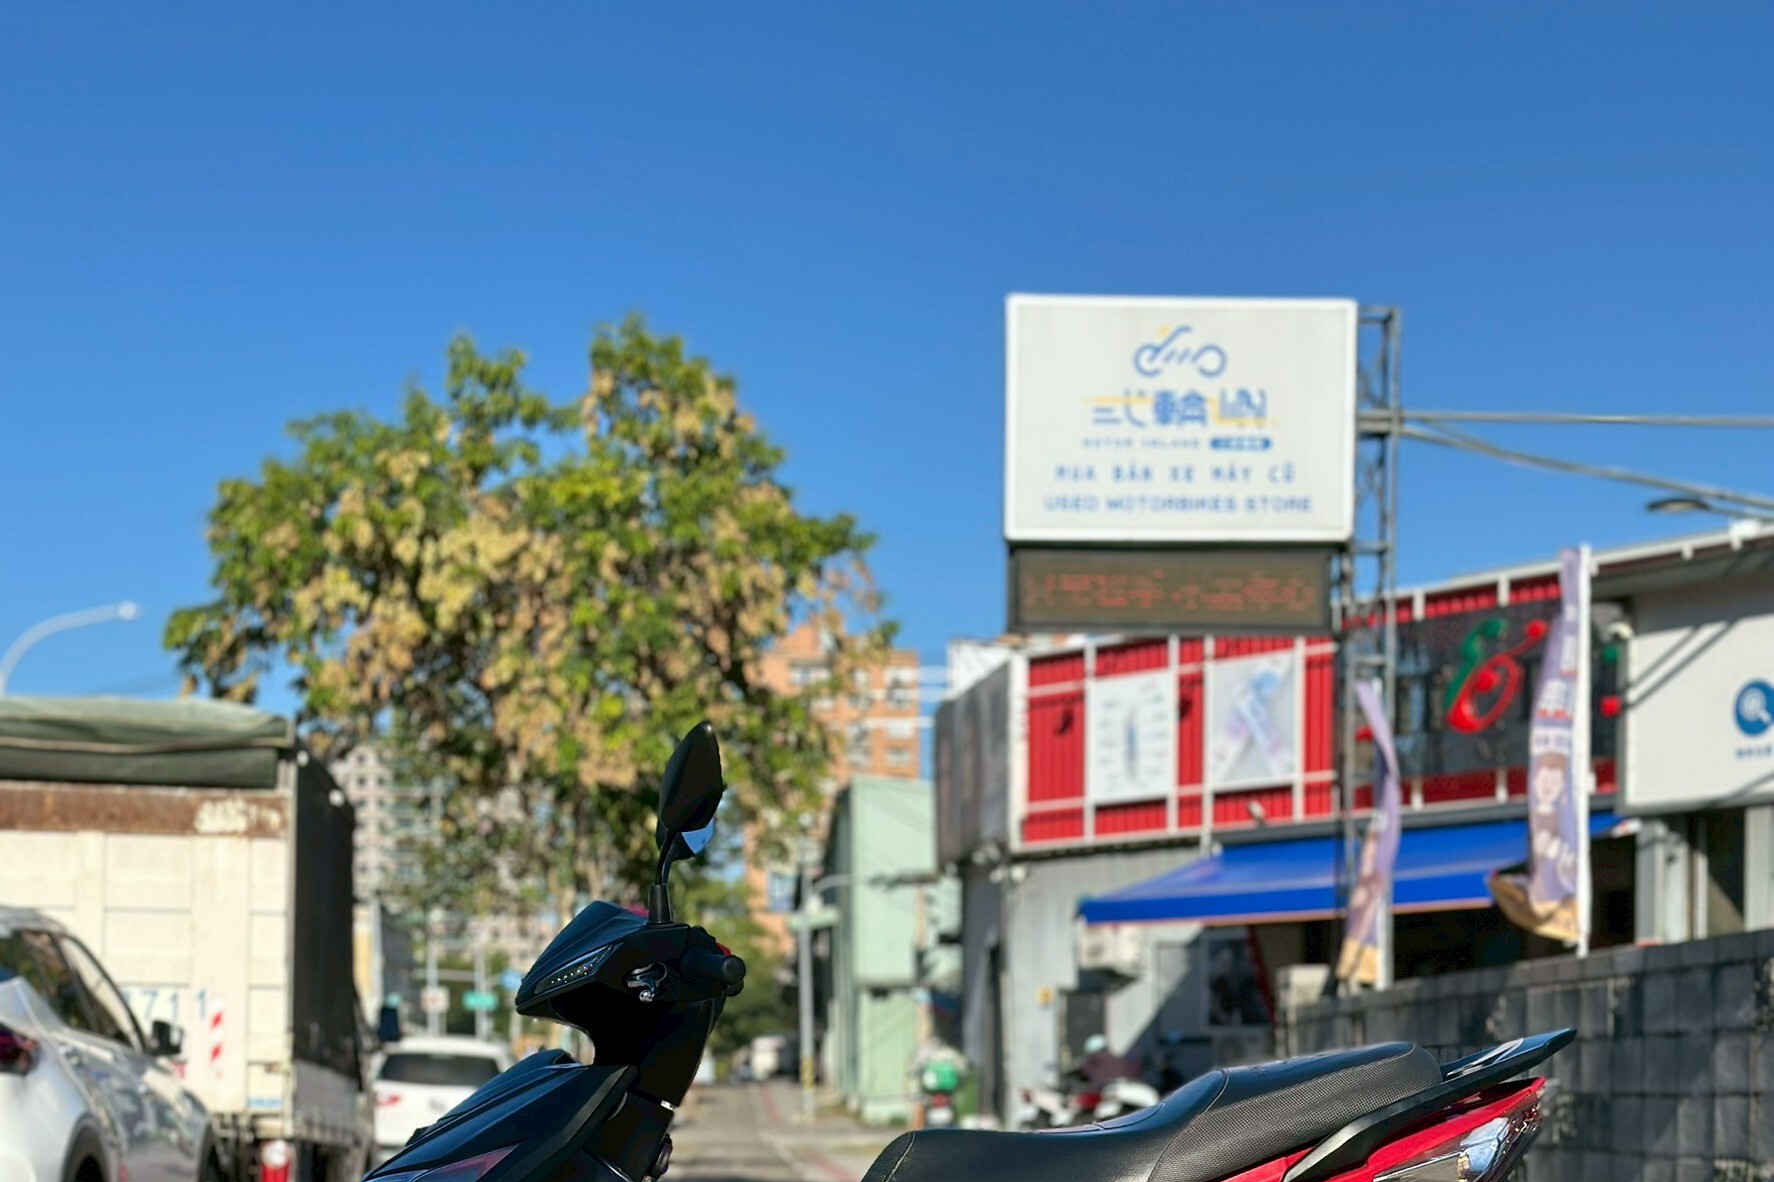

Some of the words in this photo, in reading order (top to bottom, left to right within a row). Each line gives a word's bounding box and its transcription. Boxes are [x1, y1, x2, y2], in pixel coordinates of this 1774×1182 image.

[1171, 465, 1196, 482] XE
[1044, 495, 1099, 512] USED
[1106, 495, 1238, 512] MOTORBIKES
[1245, 495, 1313, 512] STORE
